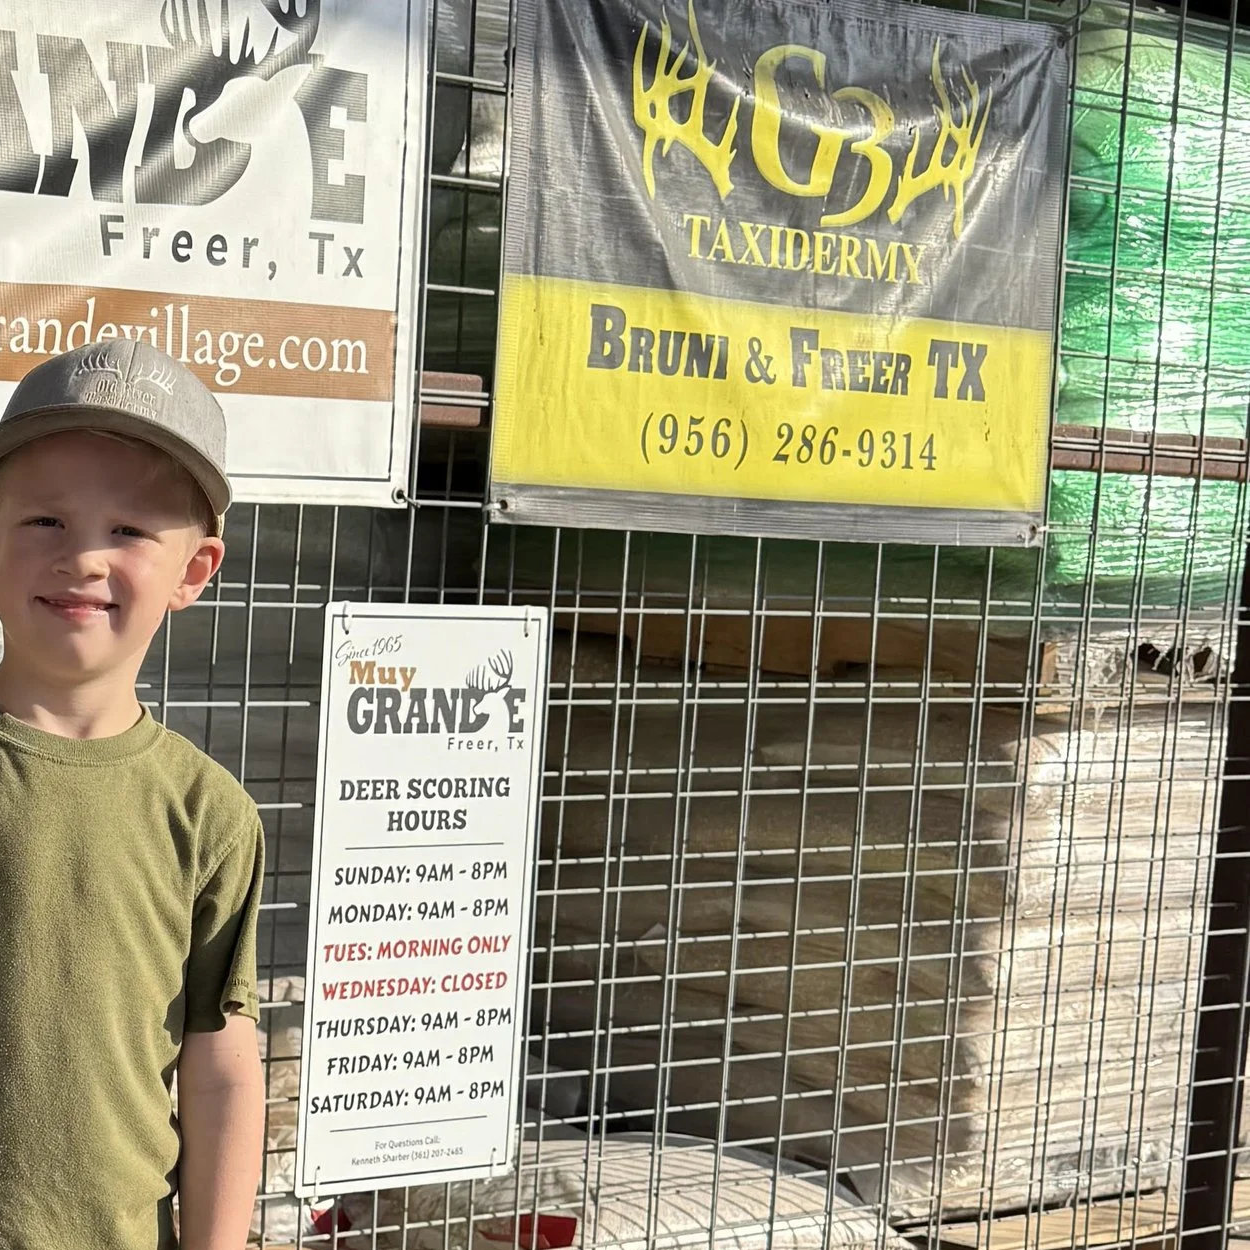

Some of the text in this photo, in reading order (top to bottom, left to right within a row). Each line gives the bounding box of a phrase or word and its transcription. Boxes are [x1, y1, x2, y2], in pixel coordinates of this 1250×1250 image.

[100, 212, 366, 281] Freer, Tx
[683, 213, 929, 285] TAXIDERMY
[743, 338, 777, 385] &
[927, 338, 988, 402] TX
[640, 411, 938, 472] (956) 286-9314
[335, 635, 403, 667] Since 1965
[349, 660, 417, 692] Muy
[346, 686, 527, 735] GRANDE
[447, 736, 524, 753] Freer, Tx
[339, 776, 511, 801] DEER SCORING
[386, 809, 468, 832] HOURS
[334, 865, 411, 886] SUNDAY:
[415, 863, 454, 883] 9AM
[471, 861, 508, 880] 8PM
[327, 903, 412, 925] MONDAY:
[417, 901, 455, 920] 9AM
[472, 898, 509, 917] 8PM
[323, 934, 513, 963] TUES: MORNING ONLY
[322, 971, 508, 1001] WEDNESDAY: CLOSED
[316, 1014, 416, 1039] THURSDAY:
[421, 1011, 459, 1032] 9AM
[475, 1007, 512, 1027] 8PM
[326, 1053, 398, 1077] FRIDAY:
[402, 1049, 441, 1069] 9AM
[457, 1045, 494, 1065] 8PM
[310, 1089, 409, 1115] SATURDAY:
[413, 1084, 451, 1105] 9AM
[469, 1080, 505, 1100] 8PM
[351, 1156, 381, 1166] Kenneth
[411, 1149, 430, 1161] (361)
[375, 1135, 441, 1150] For Questions Call:
